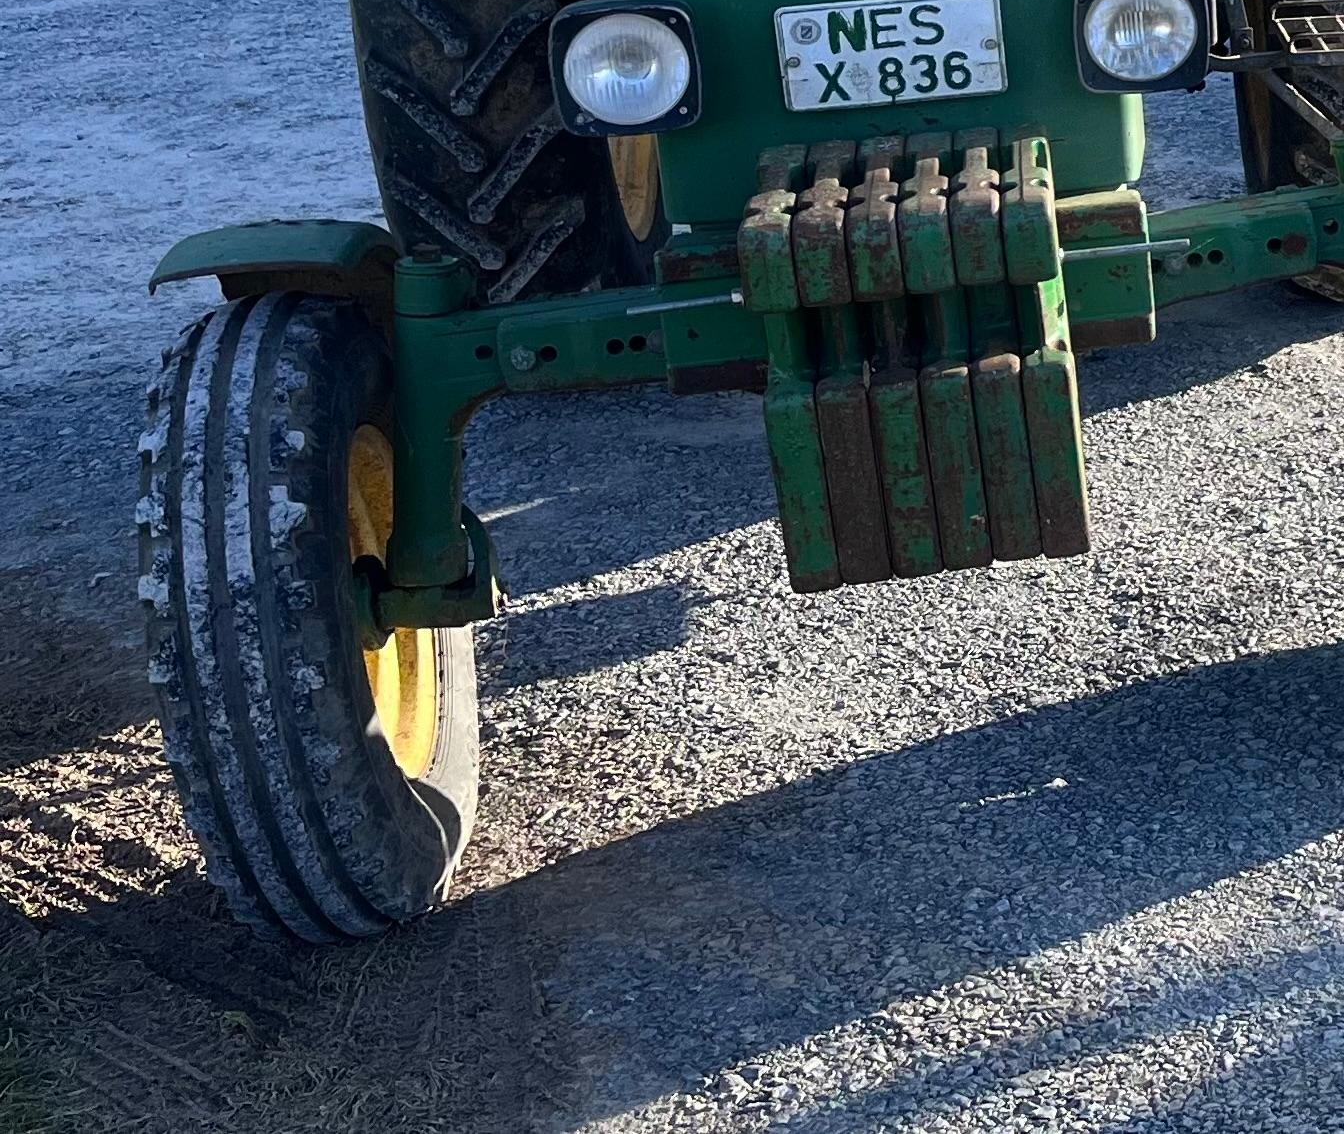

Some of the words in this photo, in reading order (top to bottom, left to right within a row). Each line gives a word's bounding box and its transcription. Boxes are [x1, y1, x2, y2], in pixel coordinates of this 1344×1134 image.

[826, 4, 945, 54] NES
[815, 61, 852, 103] X
[878, 50, 973, 97] 836
